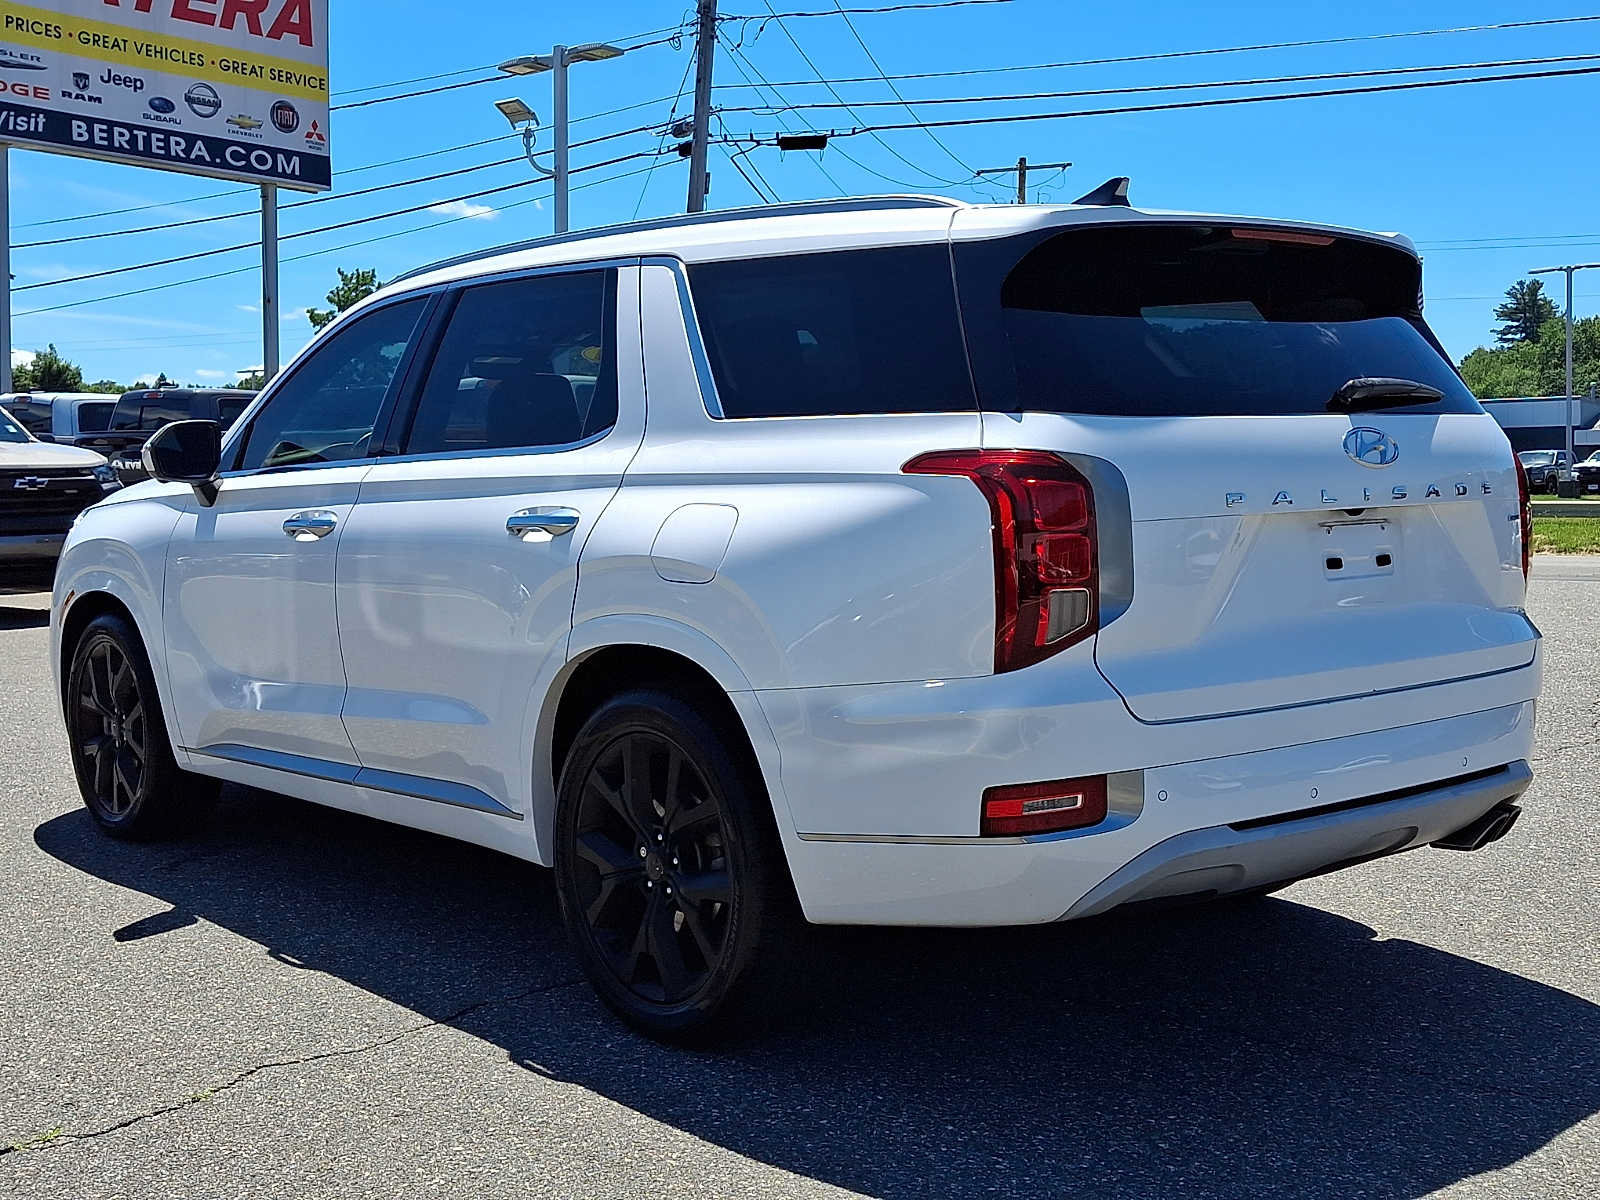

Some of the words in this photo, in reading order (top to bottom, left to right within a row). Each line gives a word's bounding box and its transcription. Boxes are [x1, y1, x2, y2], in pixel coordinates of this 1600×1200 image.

[5, 15, 62, 39] PRICES
[78, 31, 128, 53] GREAT
[134, 42, 205, 67] VEHICLES
[218, 58, 265, 79] GREAT
[269, 67, 326, 91] SERVICE
[99, 68, 145, 93] Jeep
[61, 90, 103, 105] RAM
[142, 112, 182, 125] SUBARU
[71, 119, 301, 176] BERTERA.COM
[1225, 480, 1493, 507] PALISADE
